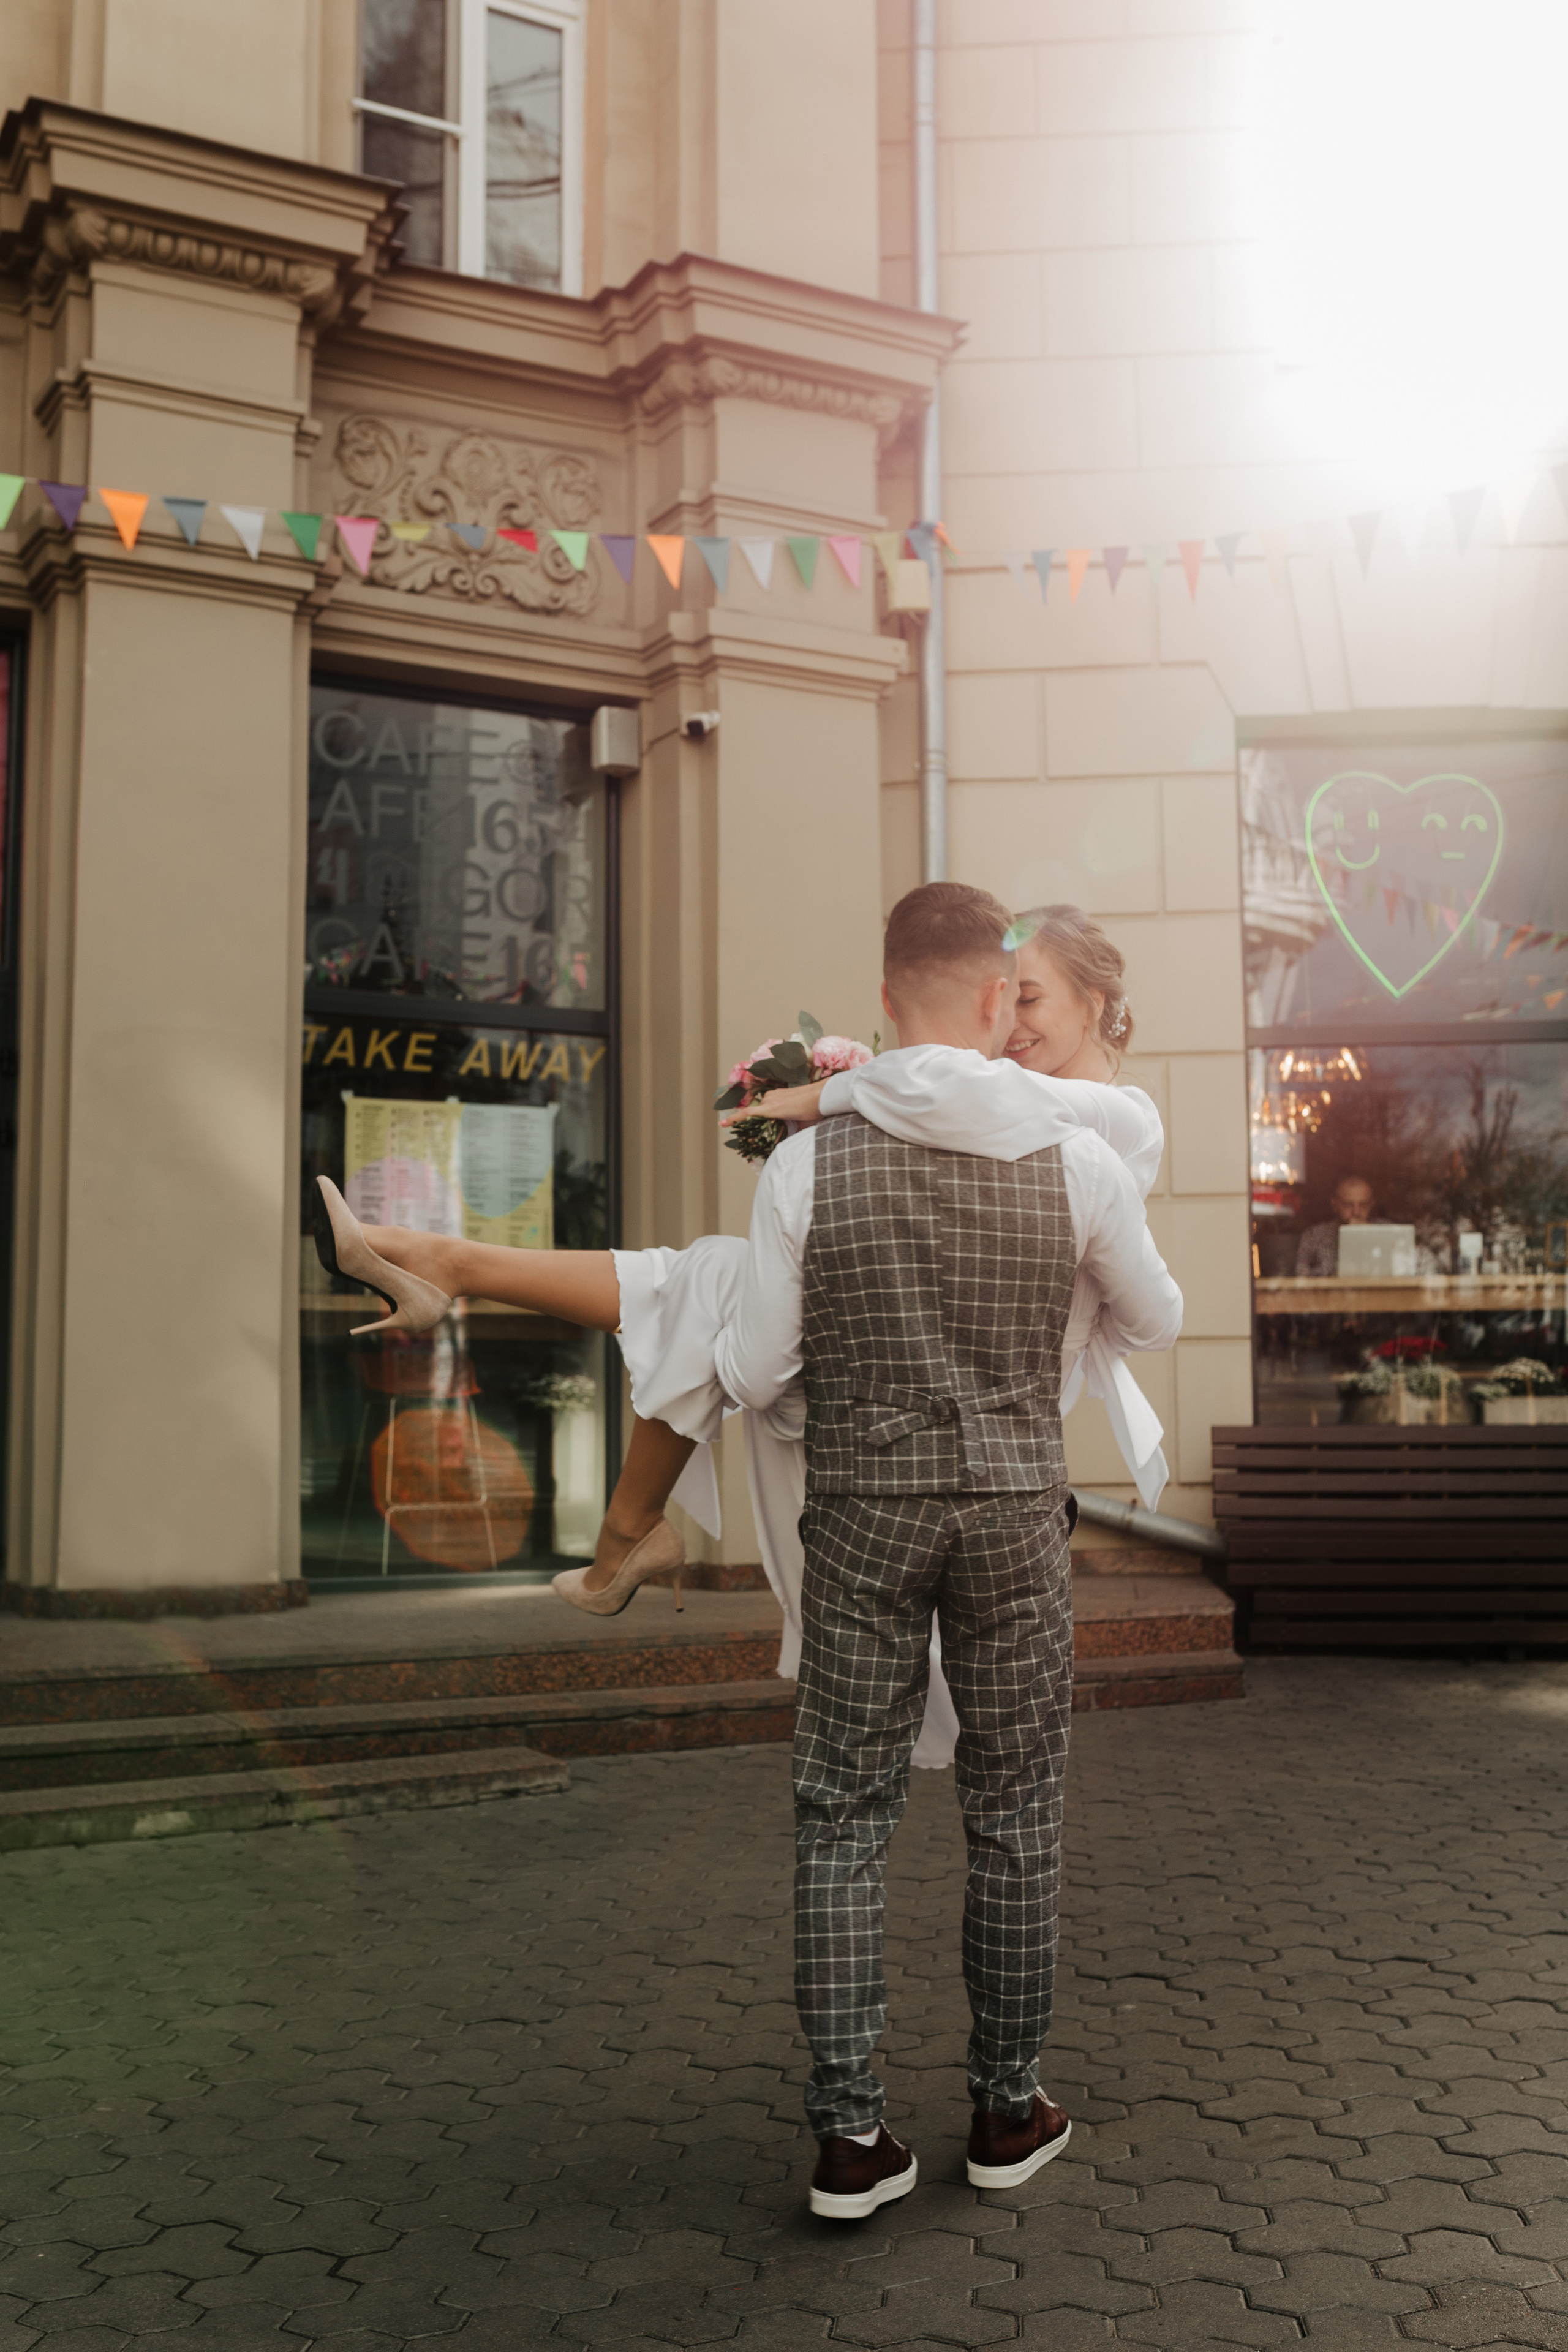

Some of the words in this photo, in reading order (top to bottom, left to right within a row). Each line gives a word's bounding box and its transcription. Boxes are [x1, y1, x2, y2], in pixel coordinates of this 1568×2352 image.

[314, 710, 500, 785] CAFE
[303, 1025, 437, 1073] TAKE
[458, 1039, 606, 1084] AWAY
